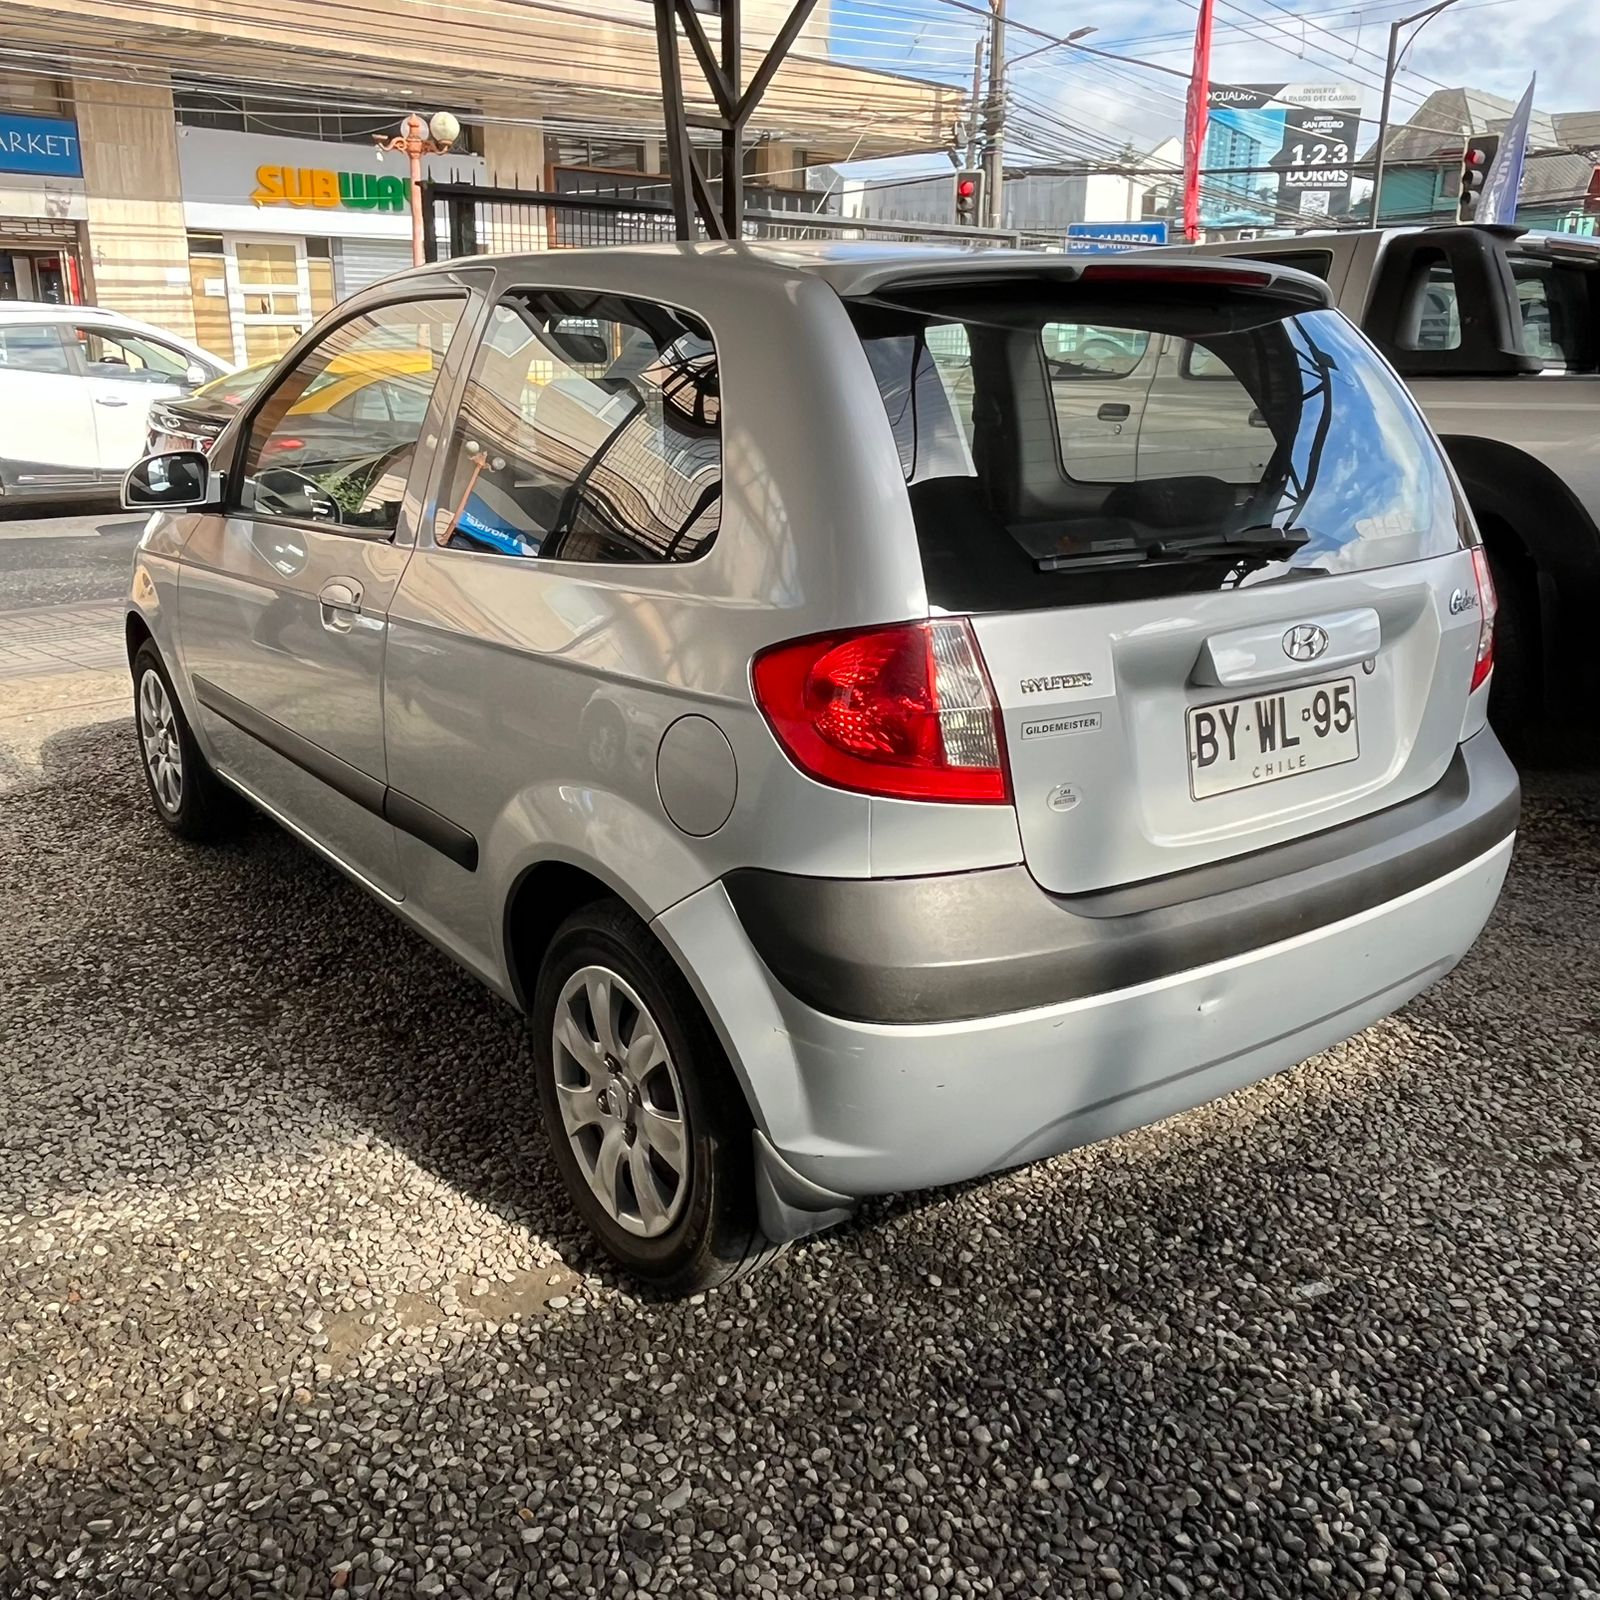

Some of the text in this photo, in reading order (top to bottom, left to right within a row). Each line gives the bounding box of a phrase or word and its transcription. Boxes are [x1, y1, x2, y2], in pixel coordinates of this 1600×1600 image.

[1302, 120, 1318, 128] SAN
[1026, 718, 1096, 735] GILDEMEISTER
[1252, 754, 1307, 779] CHILE
